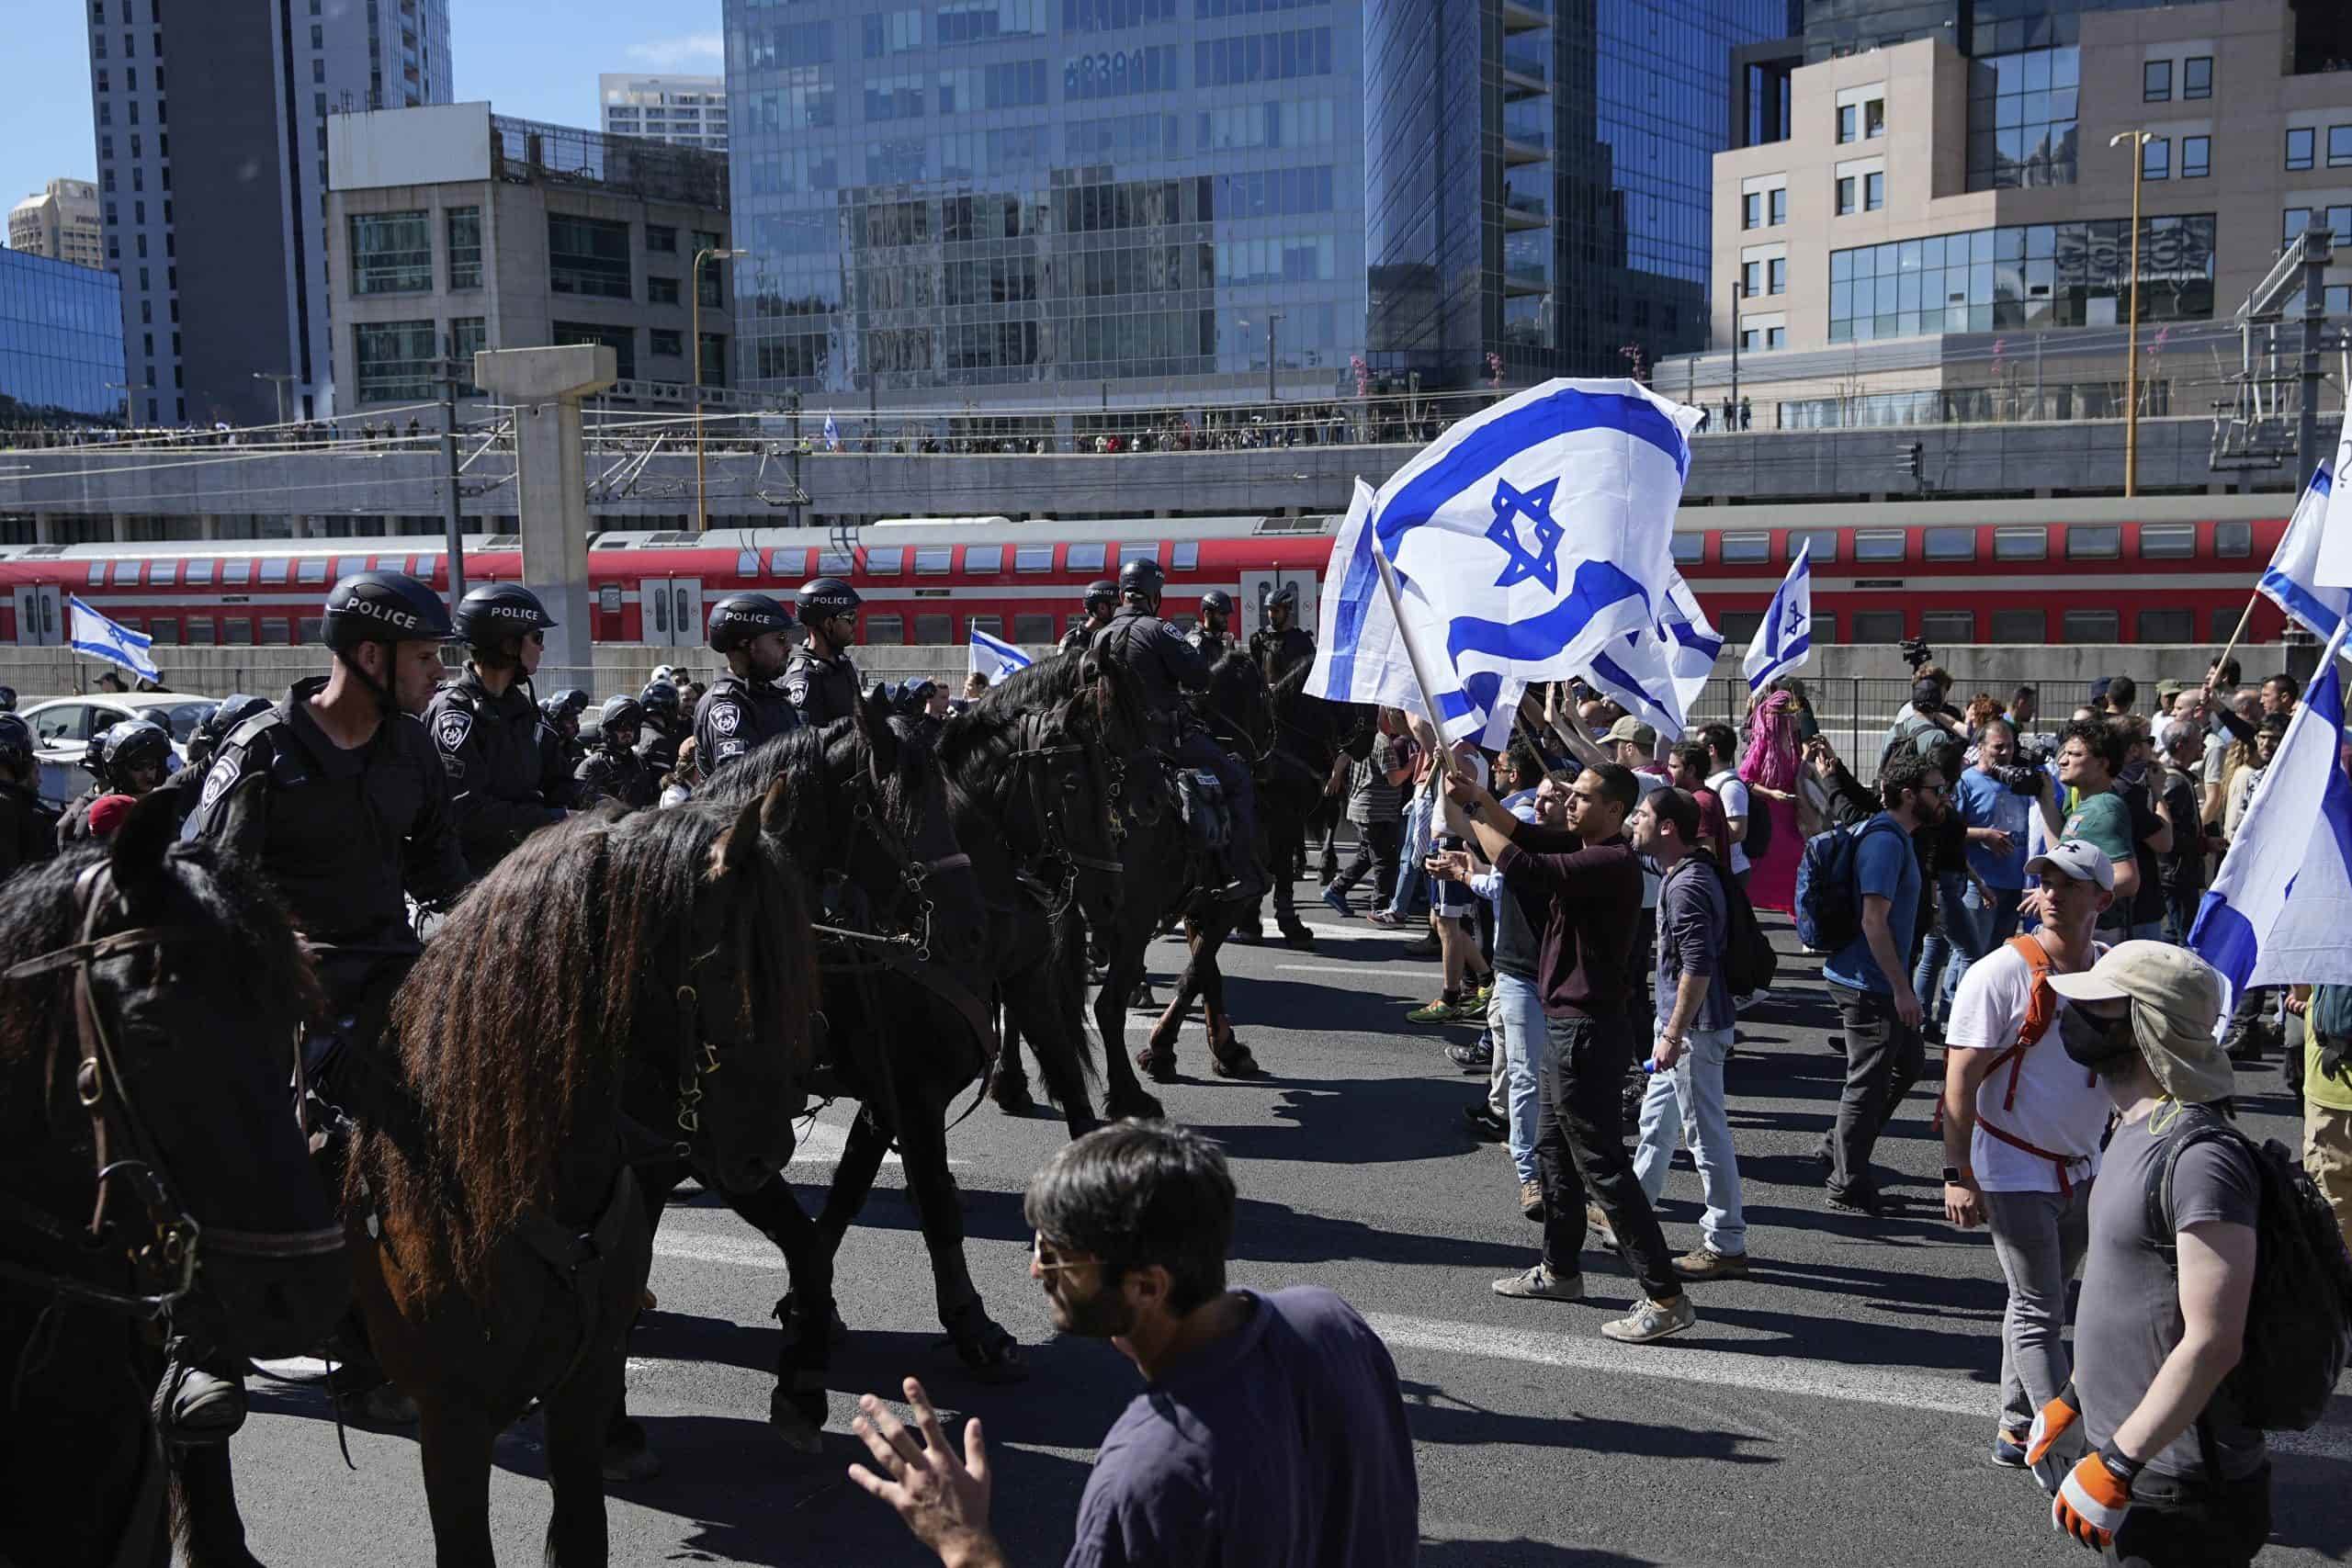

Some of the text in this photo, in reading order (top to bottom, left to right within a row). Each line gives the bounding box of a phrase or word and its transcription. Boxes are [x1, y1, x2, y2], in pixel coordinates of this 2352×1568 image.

[812, 596, 849, 604] POLICE
[345, 596, 418, 629] POLICE
[492, 607, 538, 621] POLICE
[725, 612, 772, 625] POLICE
